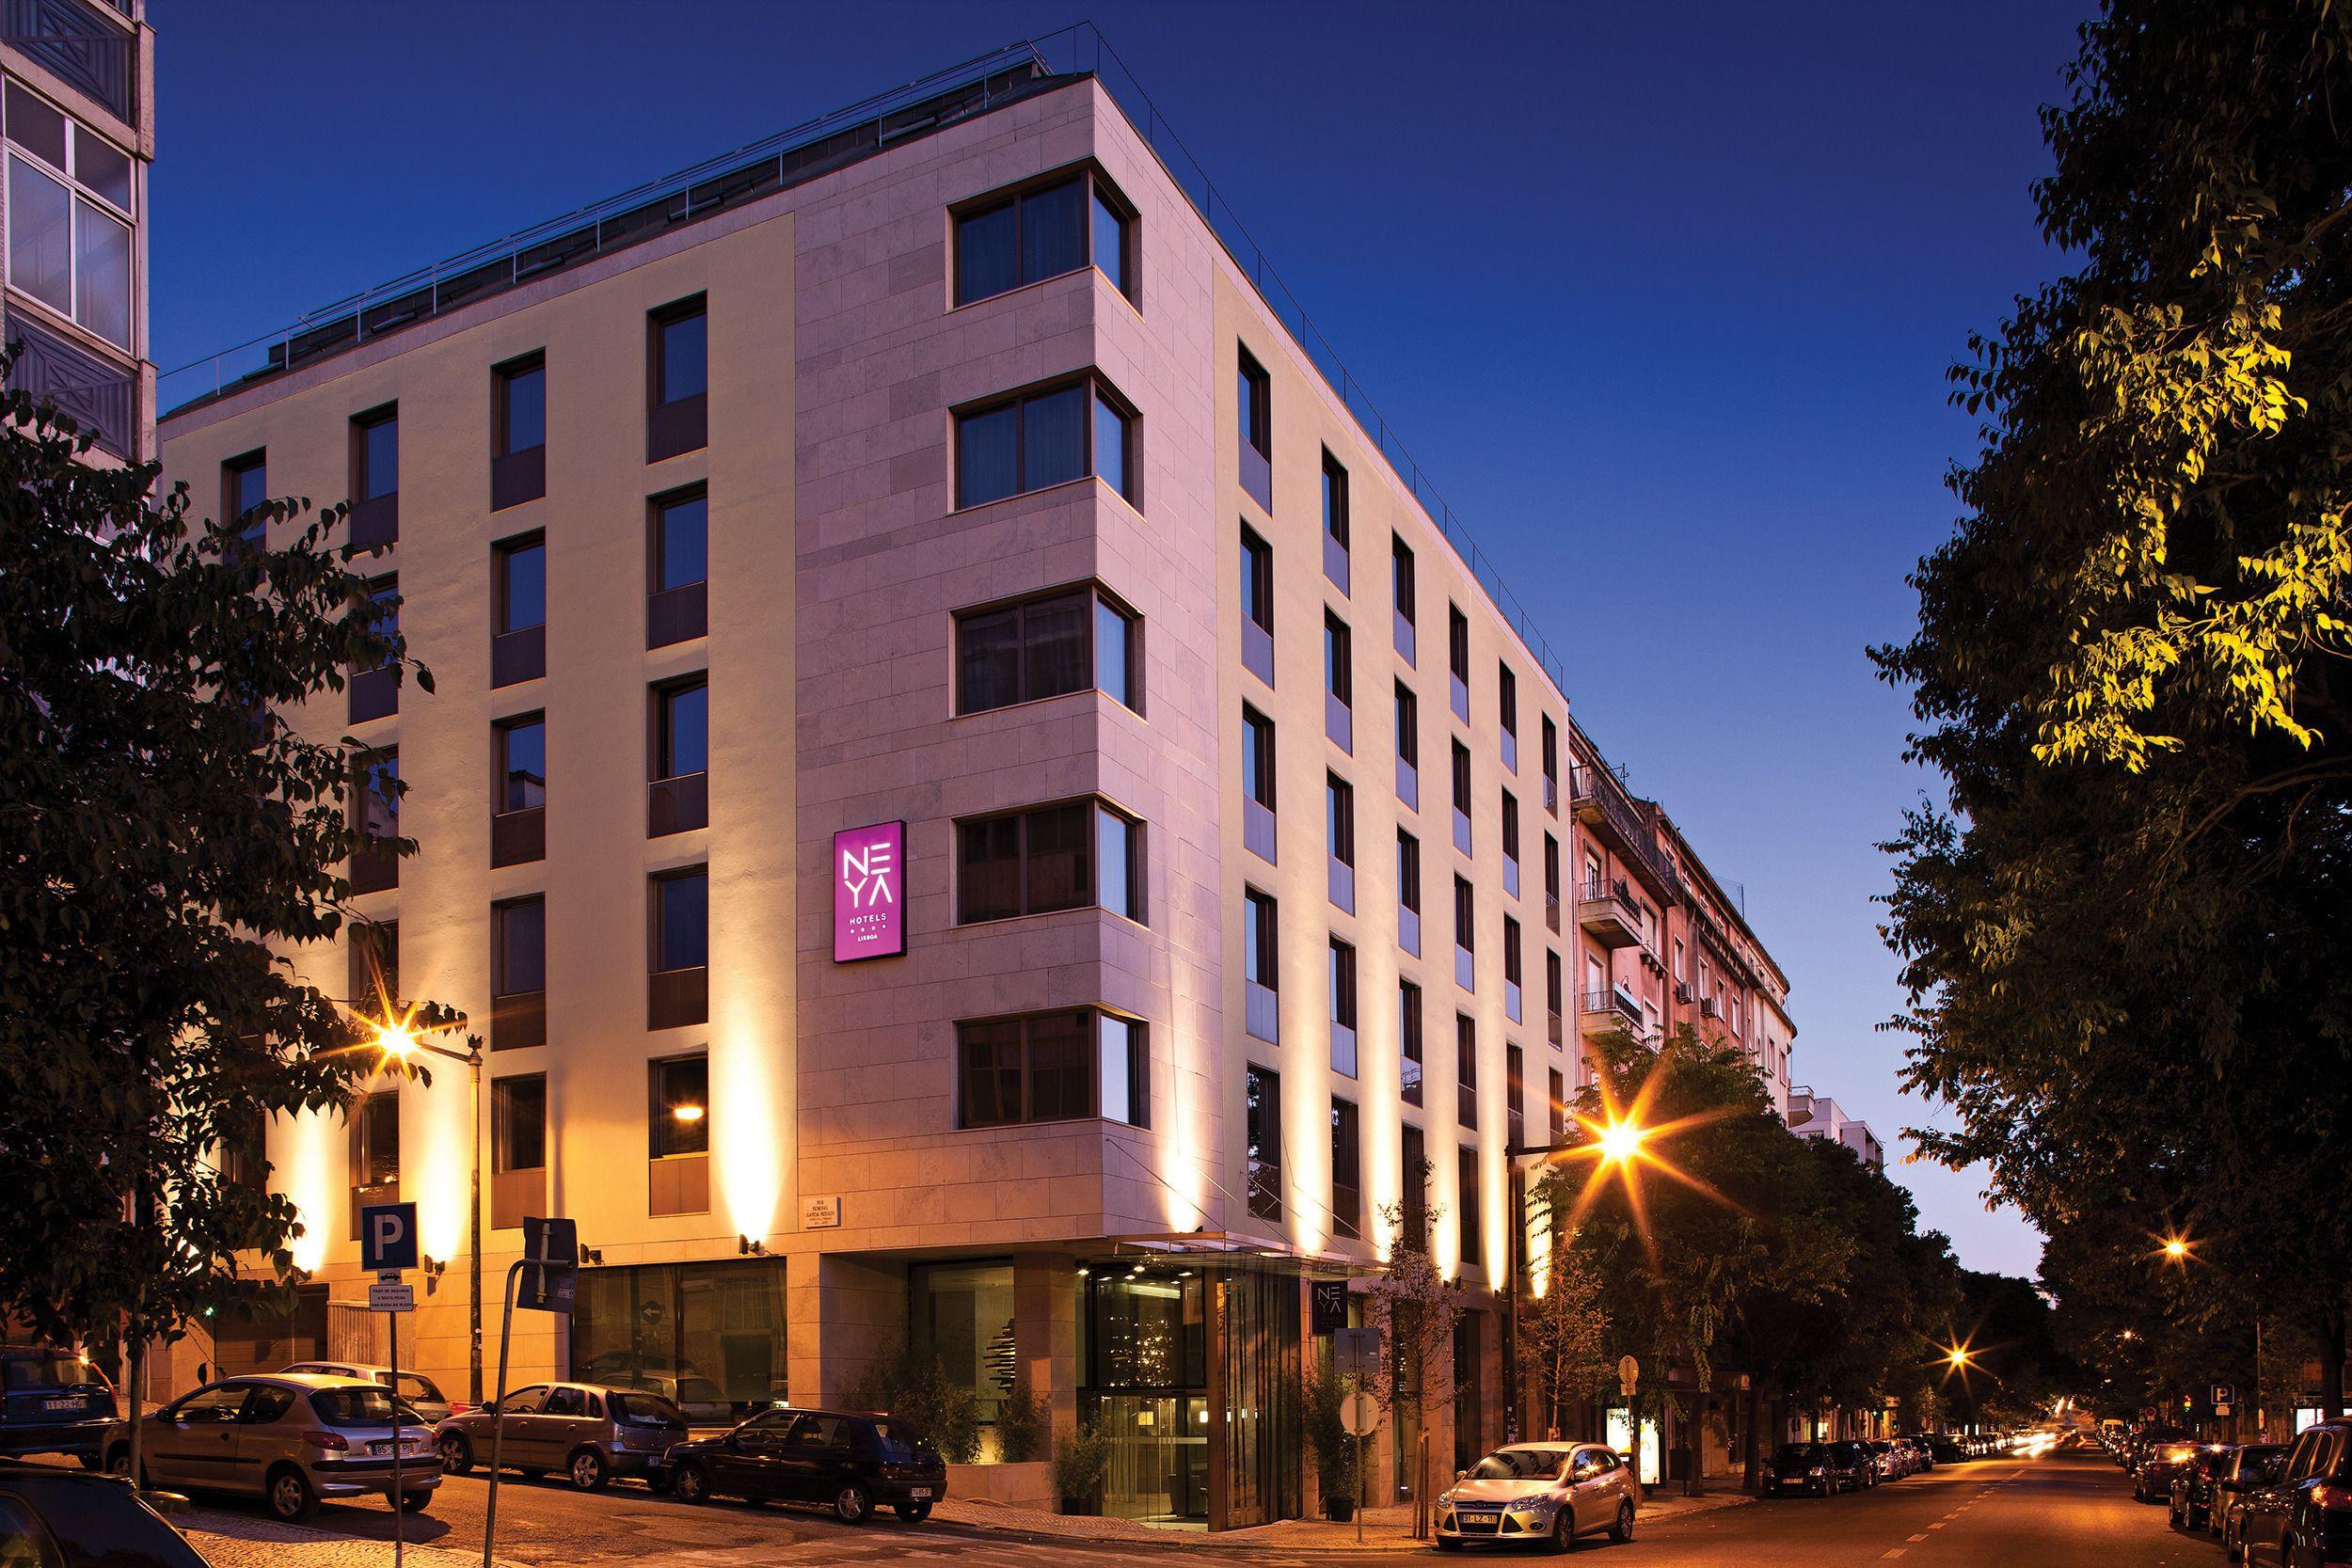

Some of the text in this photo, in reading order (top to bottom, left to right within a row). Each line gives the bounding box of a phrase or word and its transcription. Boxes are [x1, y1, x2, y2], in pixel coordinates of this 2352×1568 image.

[850, 912, 887, 926] HOTELS
[857, 933, 878, 942] LISBOA
[374, 1213, 405, 1260] P
[2217, 1386, 2229, 1402] P
[1464, 1514, 1493, 1523] 91-LZ-11
